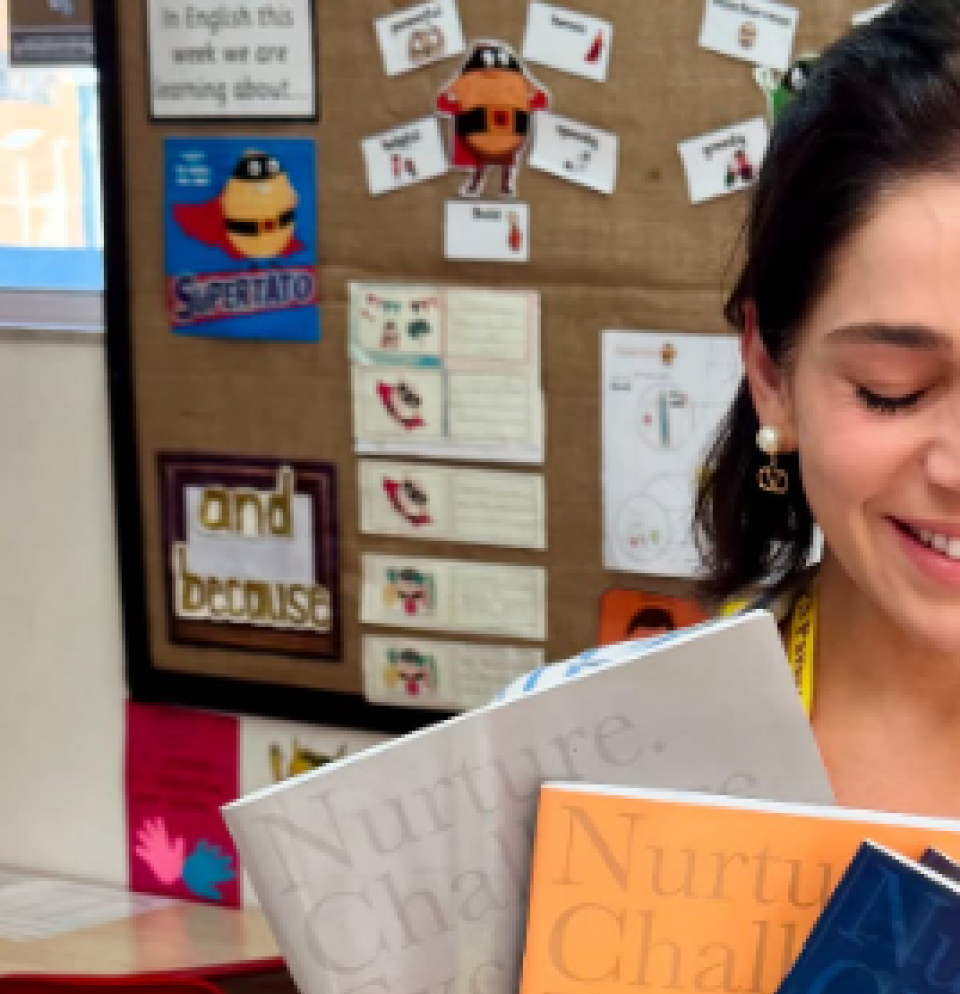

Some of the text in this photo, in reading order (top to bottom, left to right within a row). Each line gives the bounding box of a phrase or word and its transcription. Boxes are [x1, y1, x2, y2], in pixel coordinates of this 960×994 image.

[172, 40, 288, 65] week we are
[186, 4, 251, 36] English
[257, 4, 294, 29] this
[197, 466, 295, 539] and
[172, 541, 331, 634] because
[249, 714, 667, 896] Nurture.
